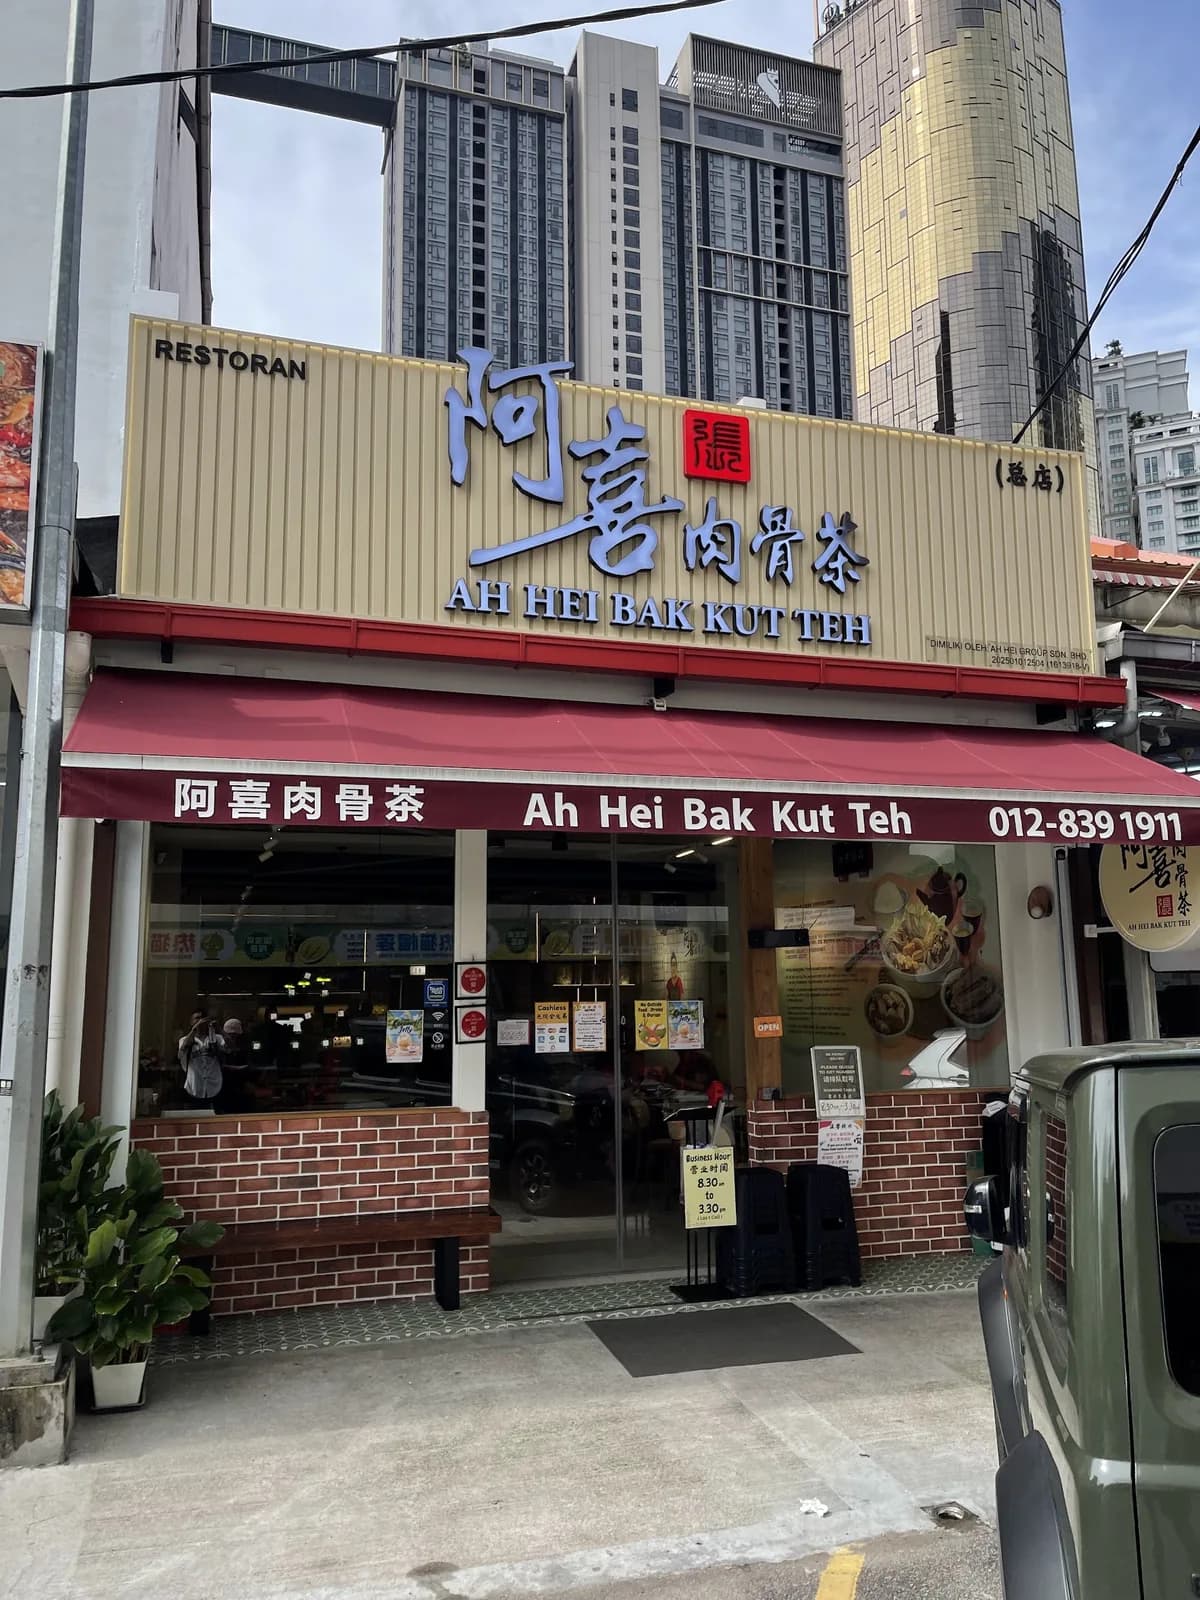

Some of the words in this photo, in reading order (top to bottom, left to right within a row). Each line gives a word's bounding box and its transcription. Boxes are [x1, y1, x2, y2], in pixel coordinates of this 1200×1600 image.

[155, 339, 306, 381] RESTORAN
[684, 496, 870, 594] 肉骨茶
[445, 577, 510, 615] AH
[523, 583, 600, 623] HEI
[611, 592, 696, 632] BAK
[702, 600, 786, 638] KUT
[792, 608, 872, 645] TEH
[930, 639, 963, 650] DIMILIKI
[990, 645, 1002, 653] AH
[1004, 646, 1017, 654] HEI
[1019, 648, 1048, 657] GROUP
[174, 779, 425, 822] 阿喜肉骨茶
[523, 792, 578, 828] Ah
[600, 795, 664, 829] Hei
[683, 797, 756, 832] Bak
[772, 800, 836, 834] Kut
[848, 802, 912, 836] Teh
[989, 807, 1115, 840] 012-839
[1119, 811, 1182, 841] 1911
[1178, 919, 1191, 927] TEH
[758, 1023, 779, 1032] OPEN
[686, 1153, 713, 1163] Business
[714, 1152, 731, 1161] Hour
[690, 1163, 728, 1174] 营业时间
[705, 1191, 714, 1200] to
